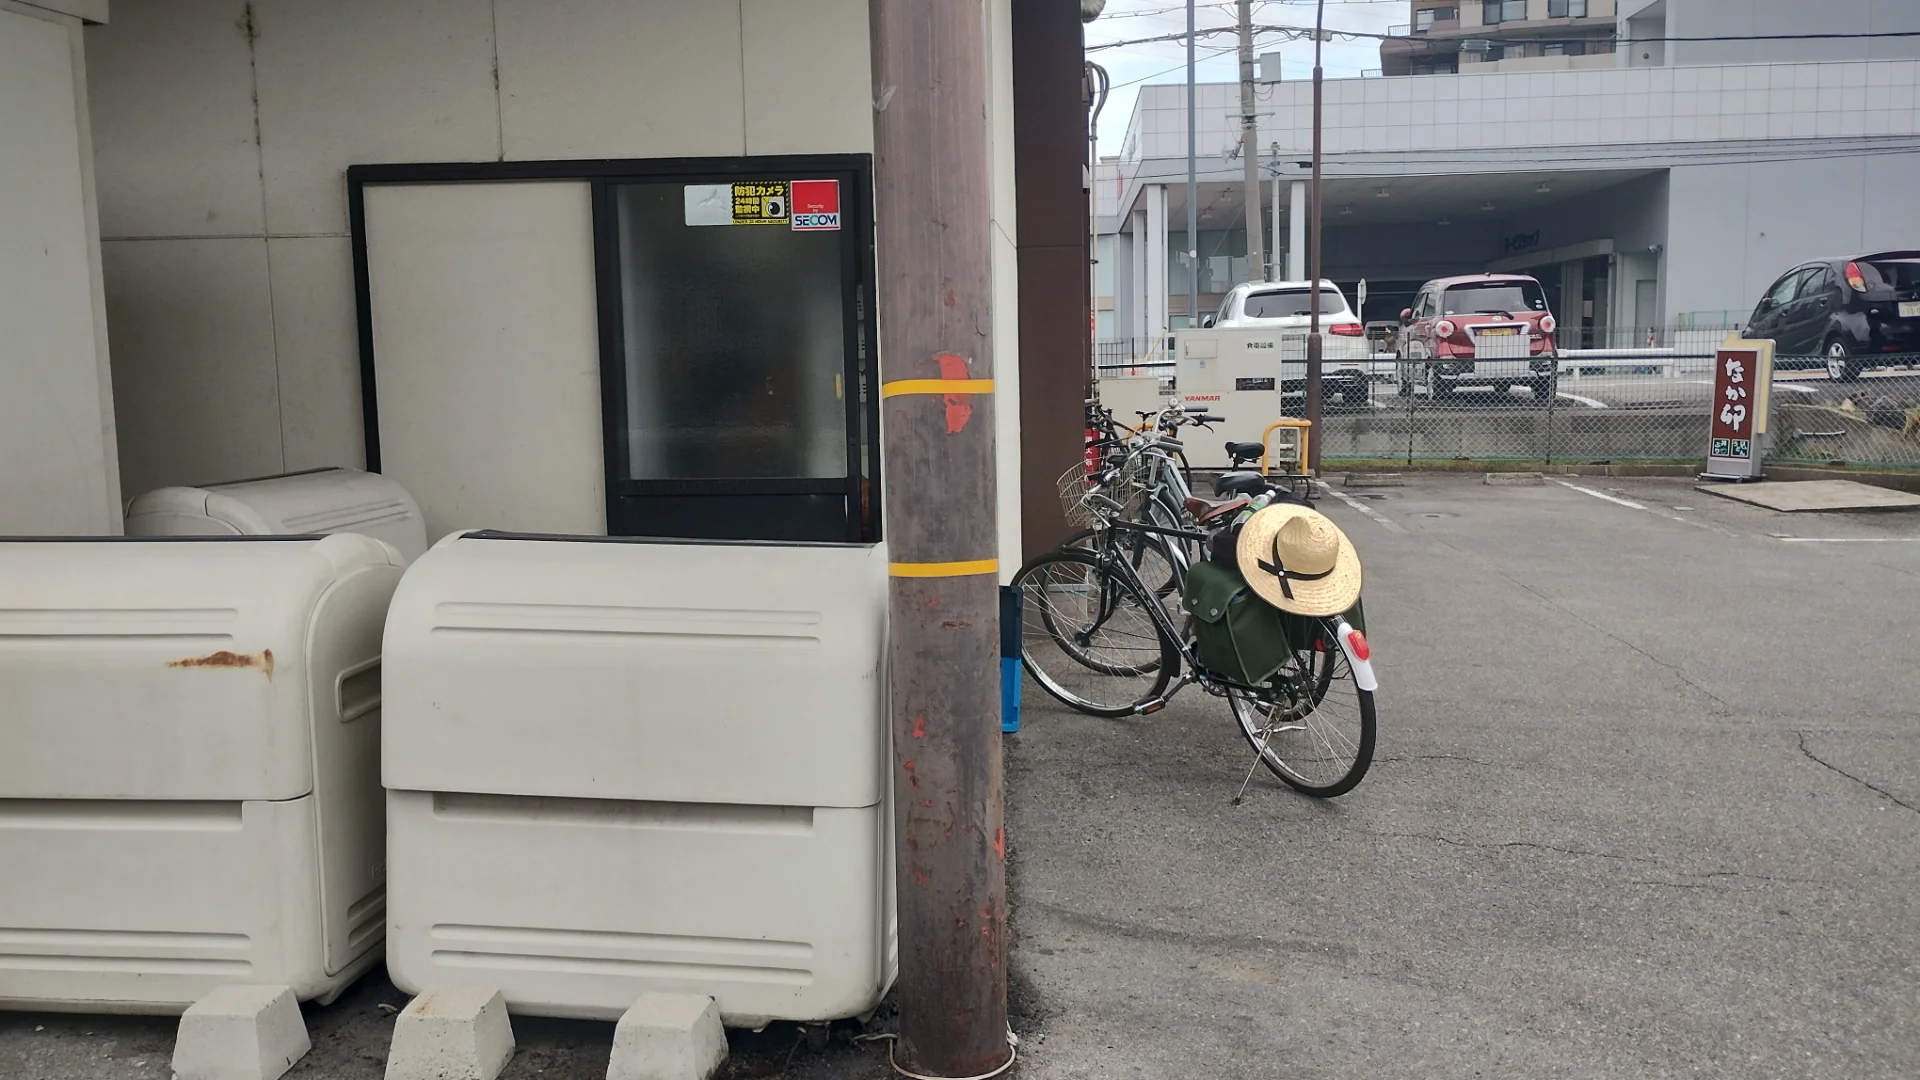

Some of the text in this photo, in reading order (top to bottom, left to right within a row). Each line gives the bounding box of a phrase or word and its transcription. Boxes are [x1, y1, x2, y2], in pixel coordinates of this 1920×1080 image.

[734, 186, 784, 196] 防犯カメラ
[735, 205, 760, 213] 監視中
[795, 214, 837, 226] SECOM
[1720, 358, 1746, 432] なか卯
